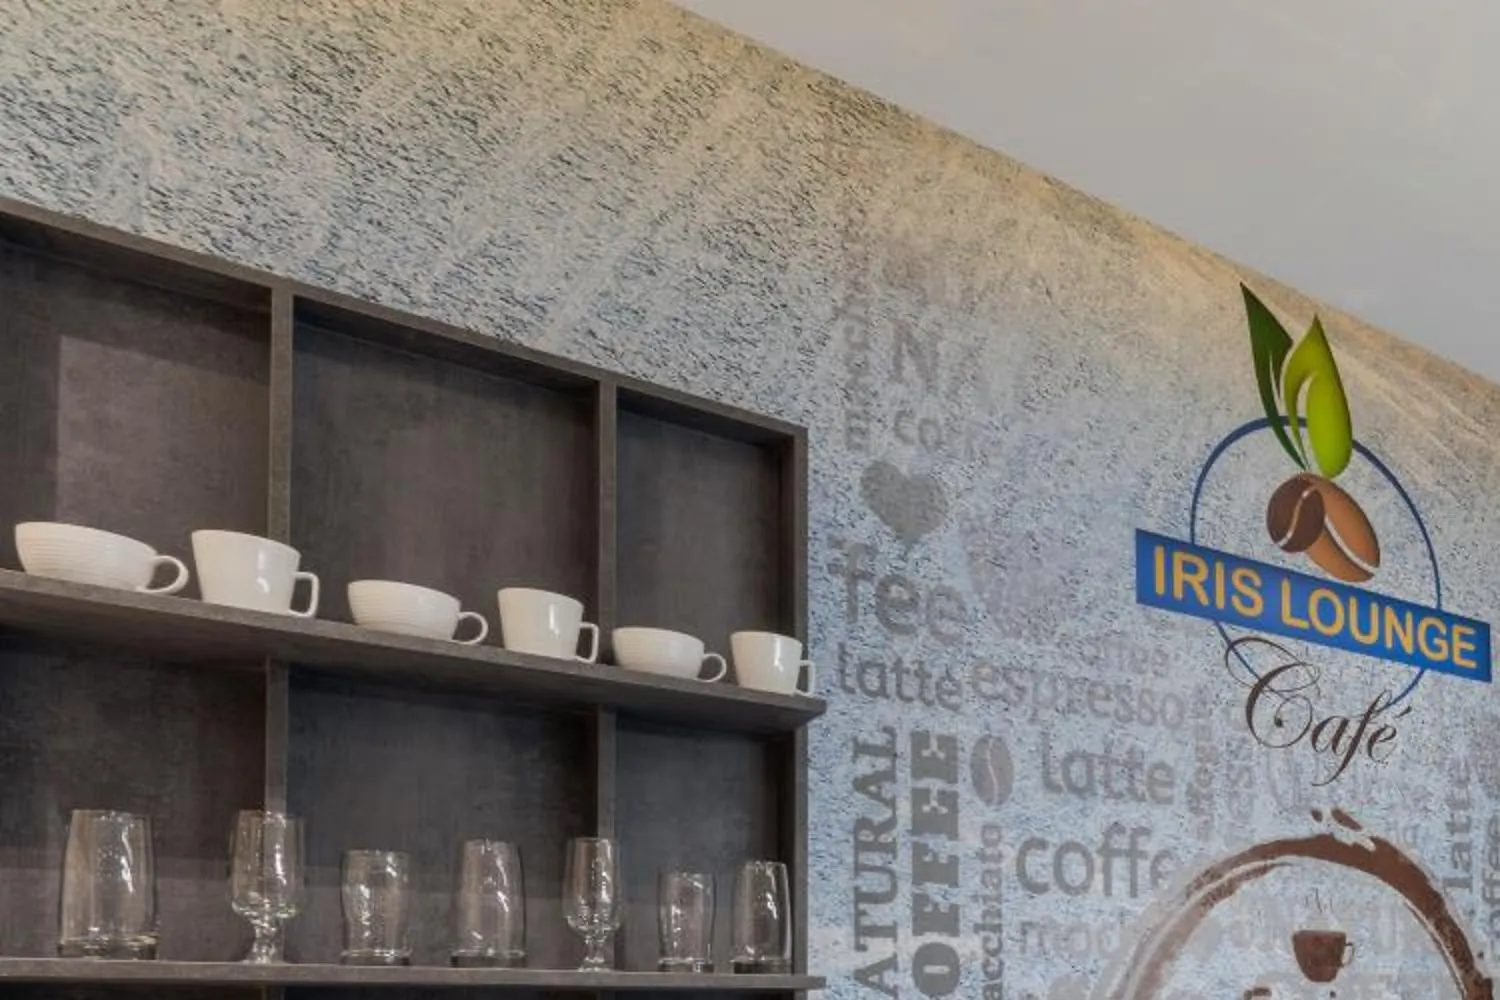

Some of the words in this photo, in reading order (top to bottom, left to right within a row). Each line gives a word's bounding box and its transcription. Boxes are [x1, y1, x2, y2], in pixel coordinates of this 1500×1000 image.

[1153, 545, 1265, 618] IRIS
[1281, 577, 1478, 670] LOUNGE
[836, 640, 964, 714] latte
[1224, 636, 1412, 788] Café
[1040, 731, 1178, 805] latte
[1014, 821, 1180, 899] coffe
